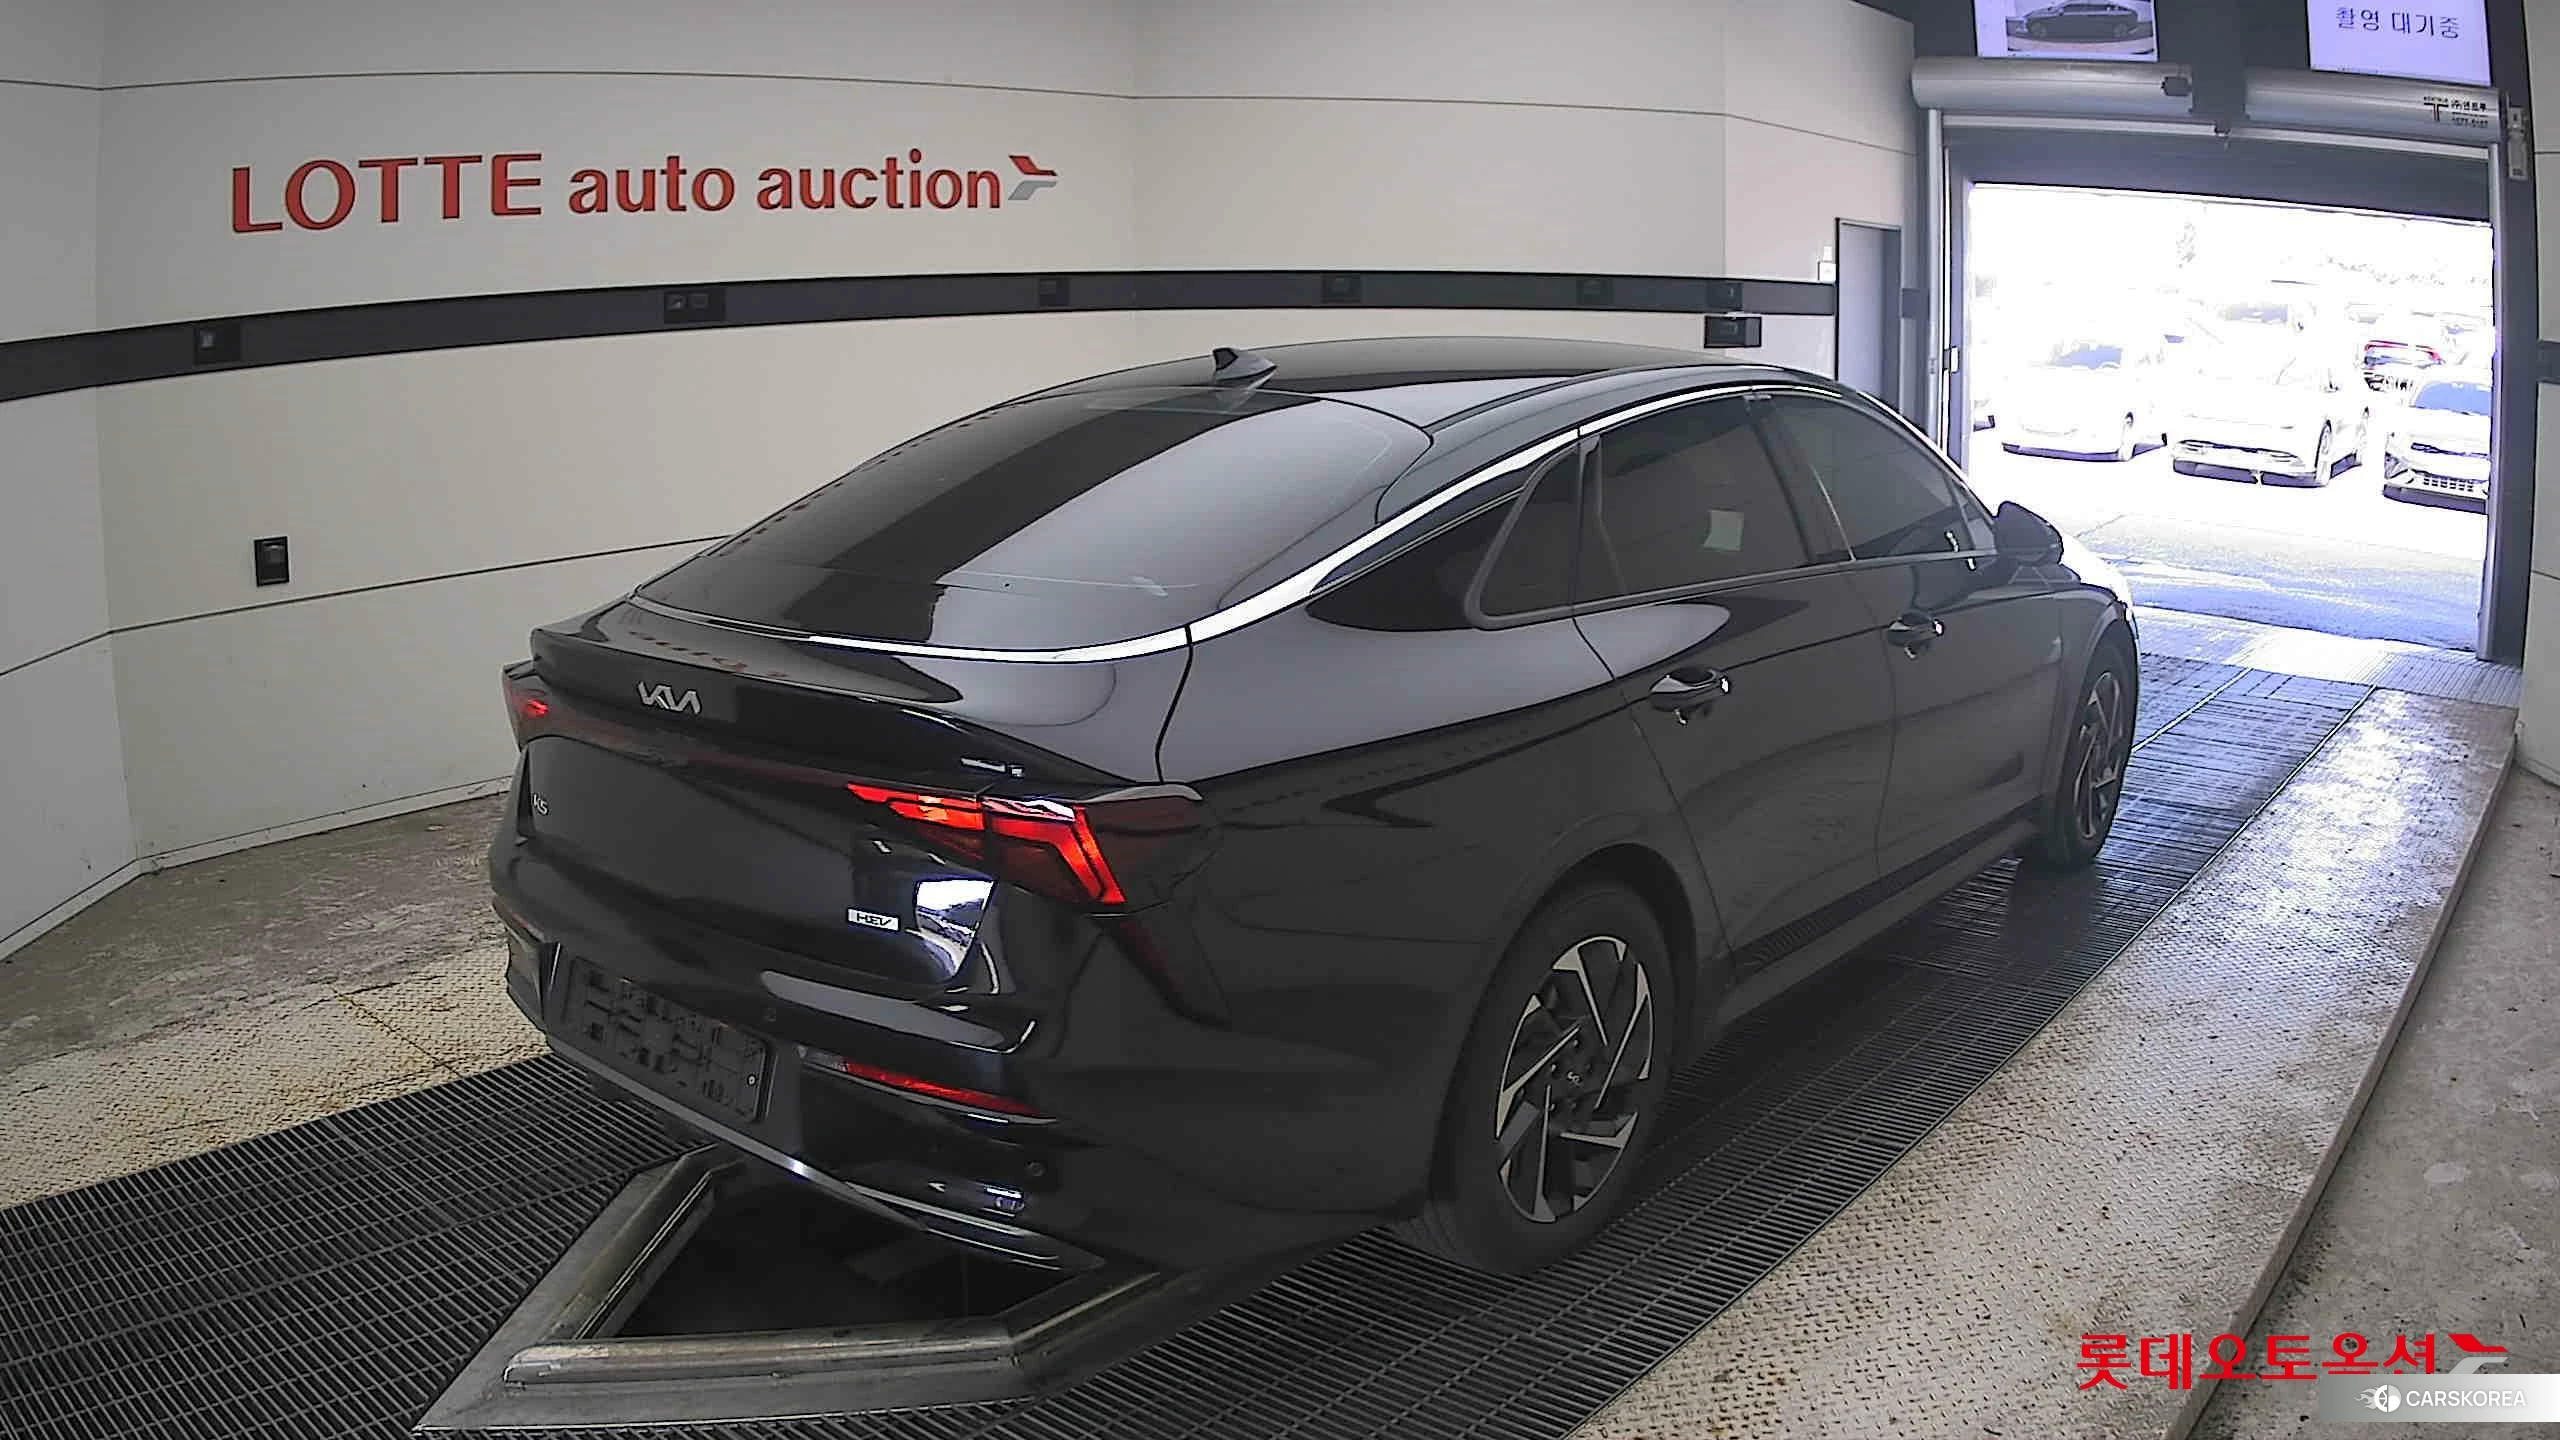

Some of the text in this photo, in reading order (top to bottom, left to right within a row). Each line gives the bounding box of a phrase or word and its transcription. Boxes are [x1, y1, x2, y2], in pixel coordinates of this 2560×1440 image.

[2336, 7, 2460, 39] 촬영 대기중
[231, 148, 1001, 233] LOTTE auto auction
[638, 681, 701, 715] KIA
